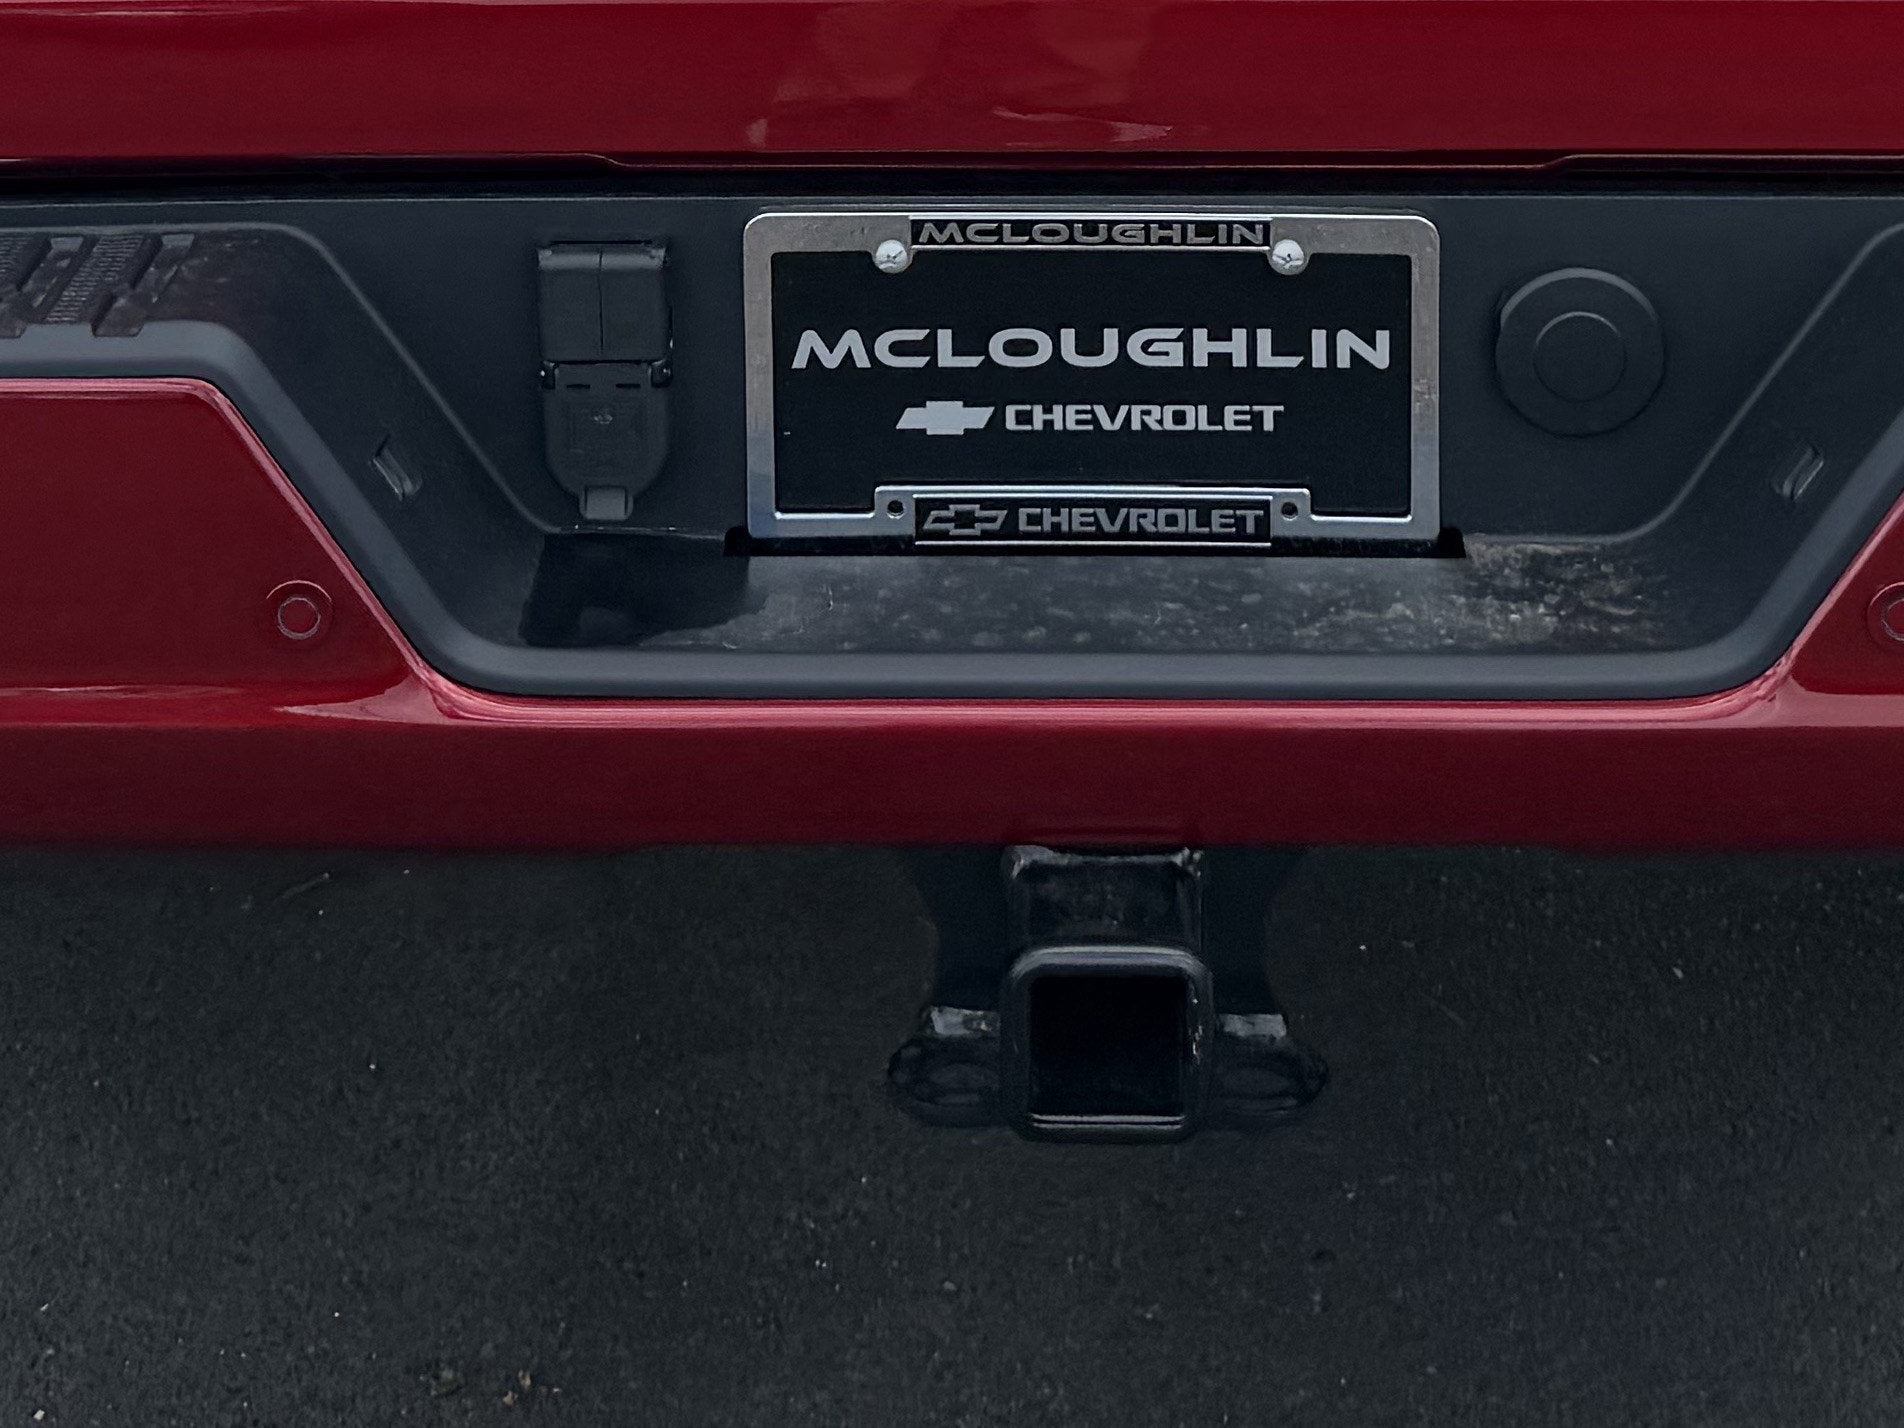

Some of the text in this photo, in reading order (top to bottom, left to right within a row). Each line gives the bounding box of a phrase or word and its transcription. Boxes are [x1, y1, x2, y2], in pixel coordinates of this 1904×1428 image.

[919, 222, 1266, 246] MCLOUGHLIN
[790, 327, 1392, 370] MCLOUGHLIN
[1005, 404, 1285, 432] CHEVROLET
[1017, 506, 1265, 535] CHEVROLET
